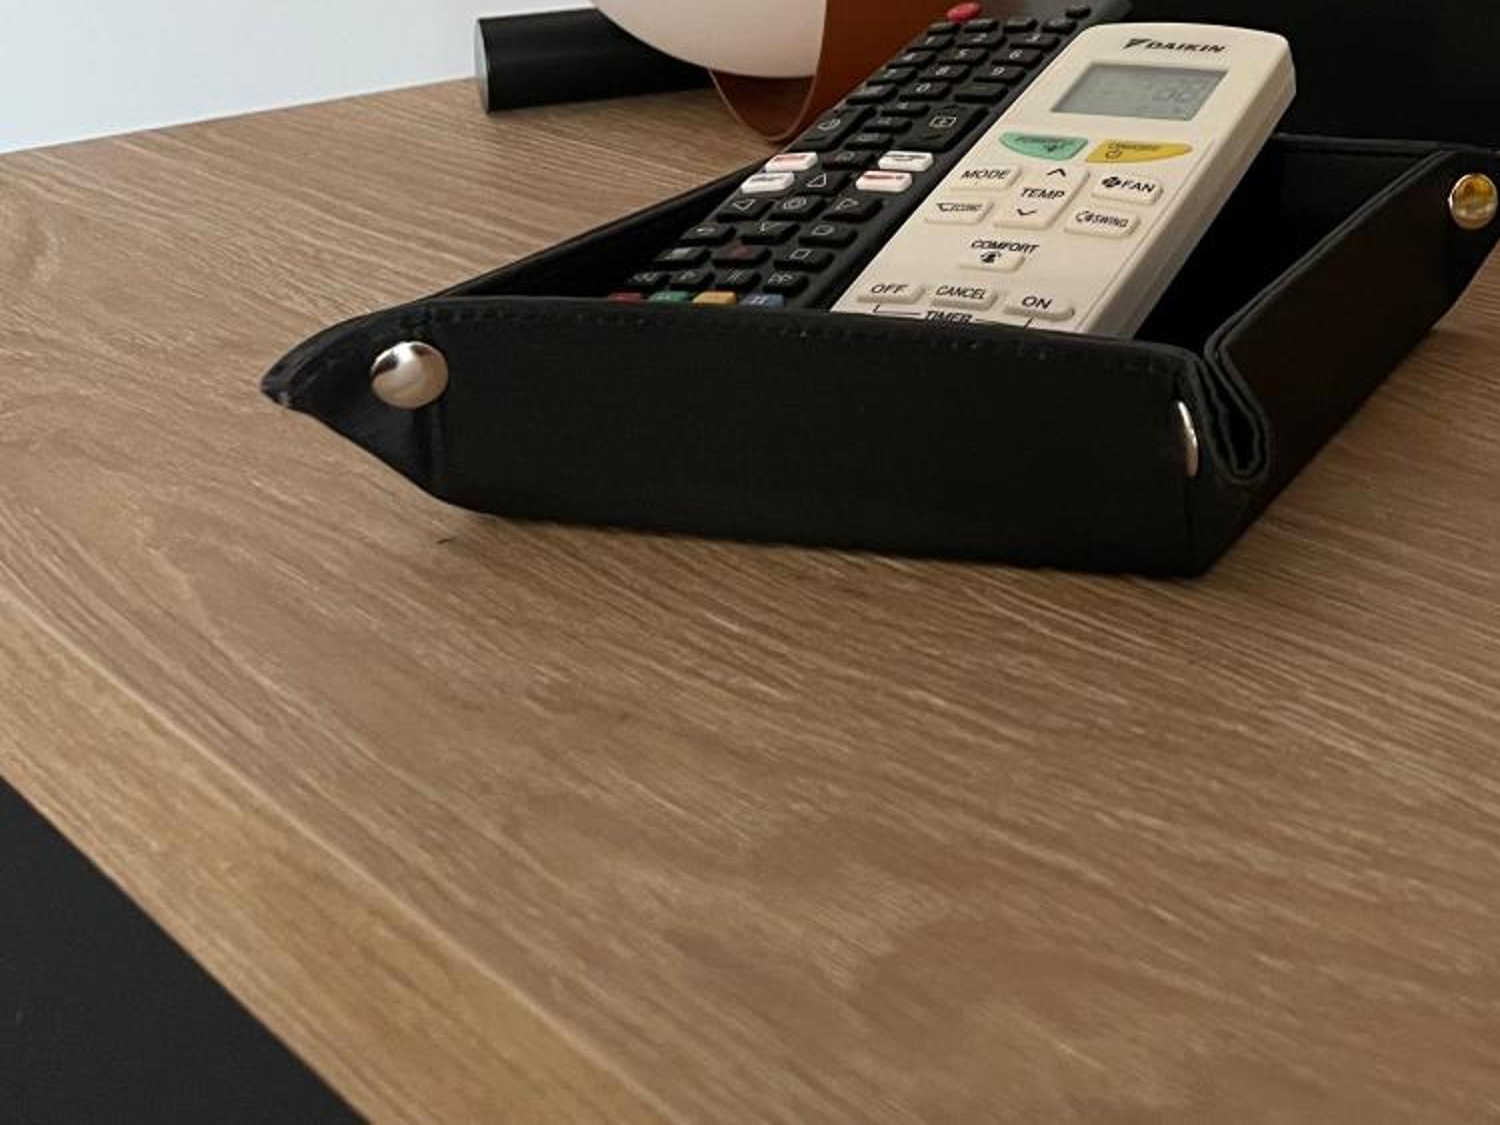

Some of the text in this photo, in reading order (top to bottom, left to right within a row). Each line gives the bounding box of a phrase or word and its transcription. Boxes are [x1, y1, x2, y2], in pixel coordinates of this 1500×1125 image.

[1145, 41, 1226, 52] DAIKIN
[962, 169, 1011, 179] MODE
[1020, 187, 1065, 199] TEMP
[1122, 180, 1156, 193] FAN
[1091, 214, 1129, 227] SWING
[971, 239, 1040, 253] COMFORT
[871, 283, 908, 294] OFF
[935, 285, 987, 300] CANCEL
[1021, 296, 1053, 309] ON
[927, 310, 974, 324] TIMER
